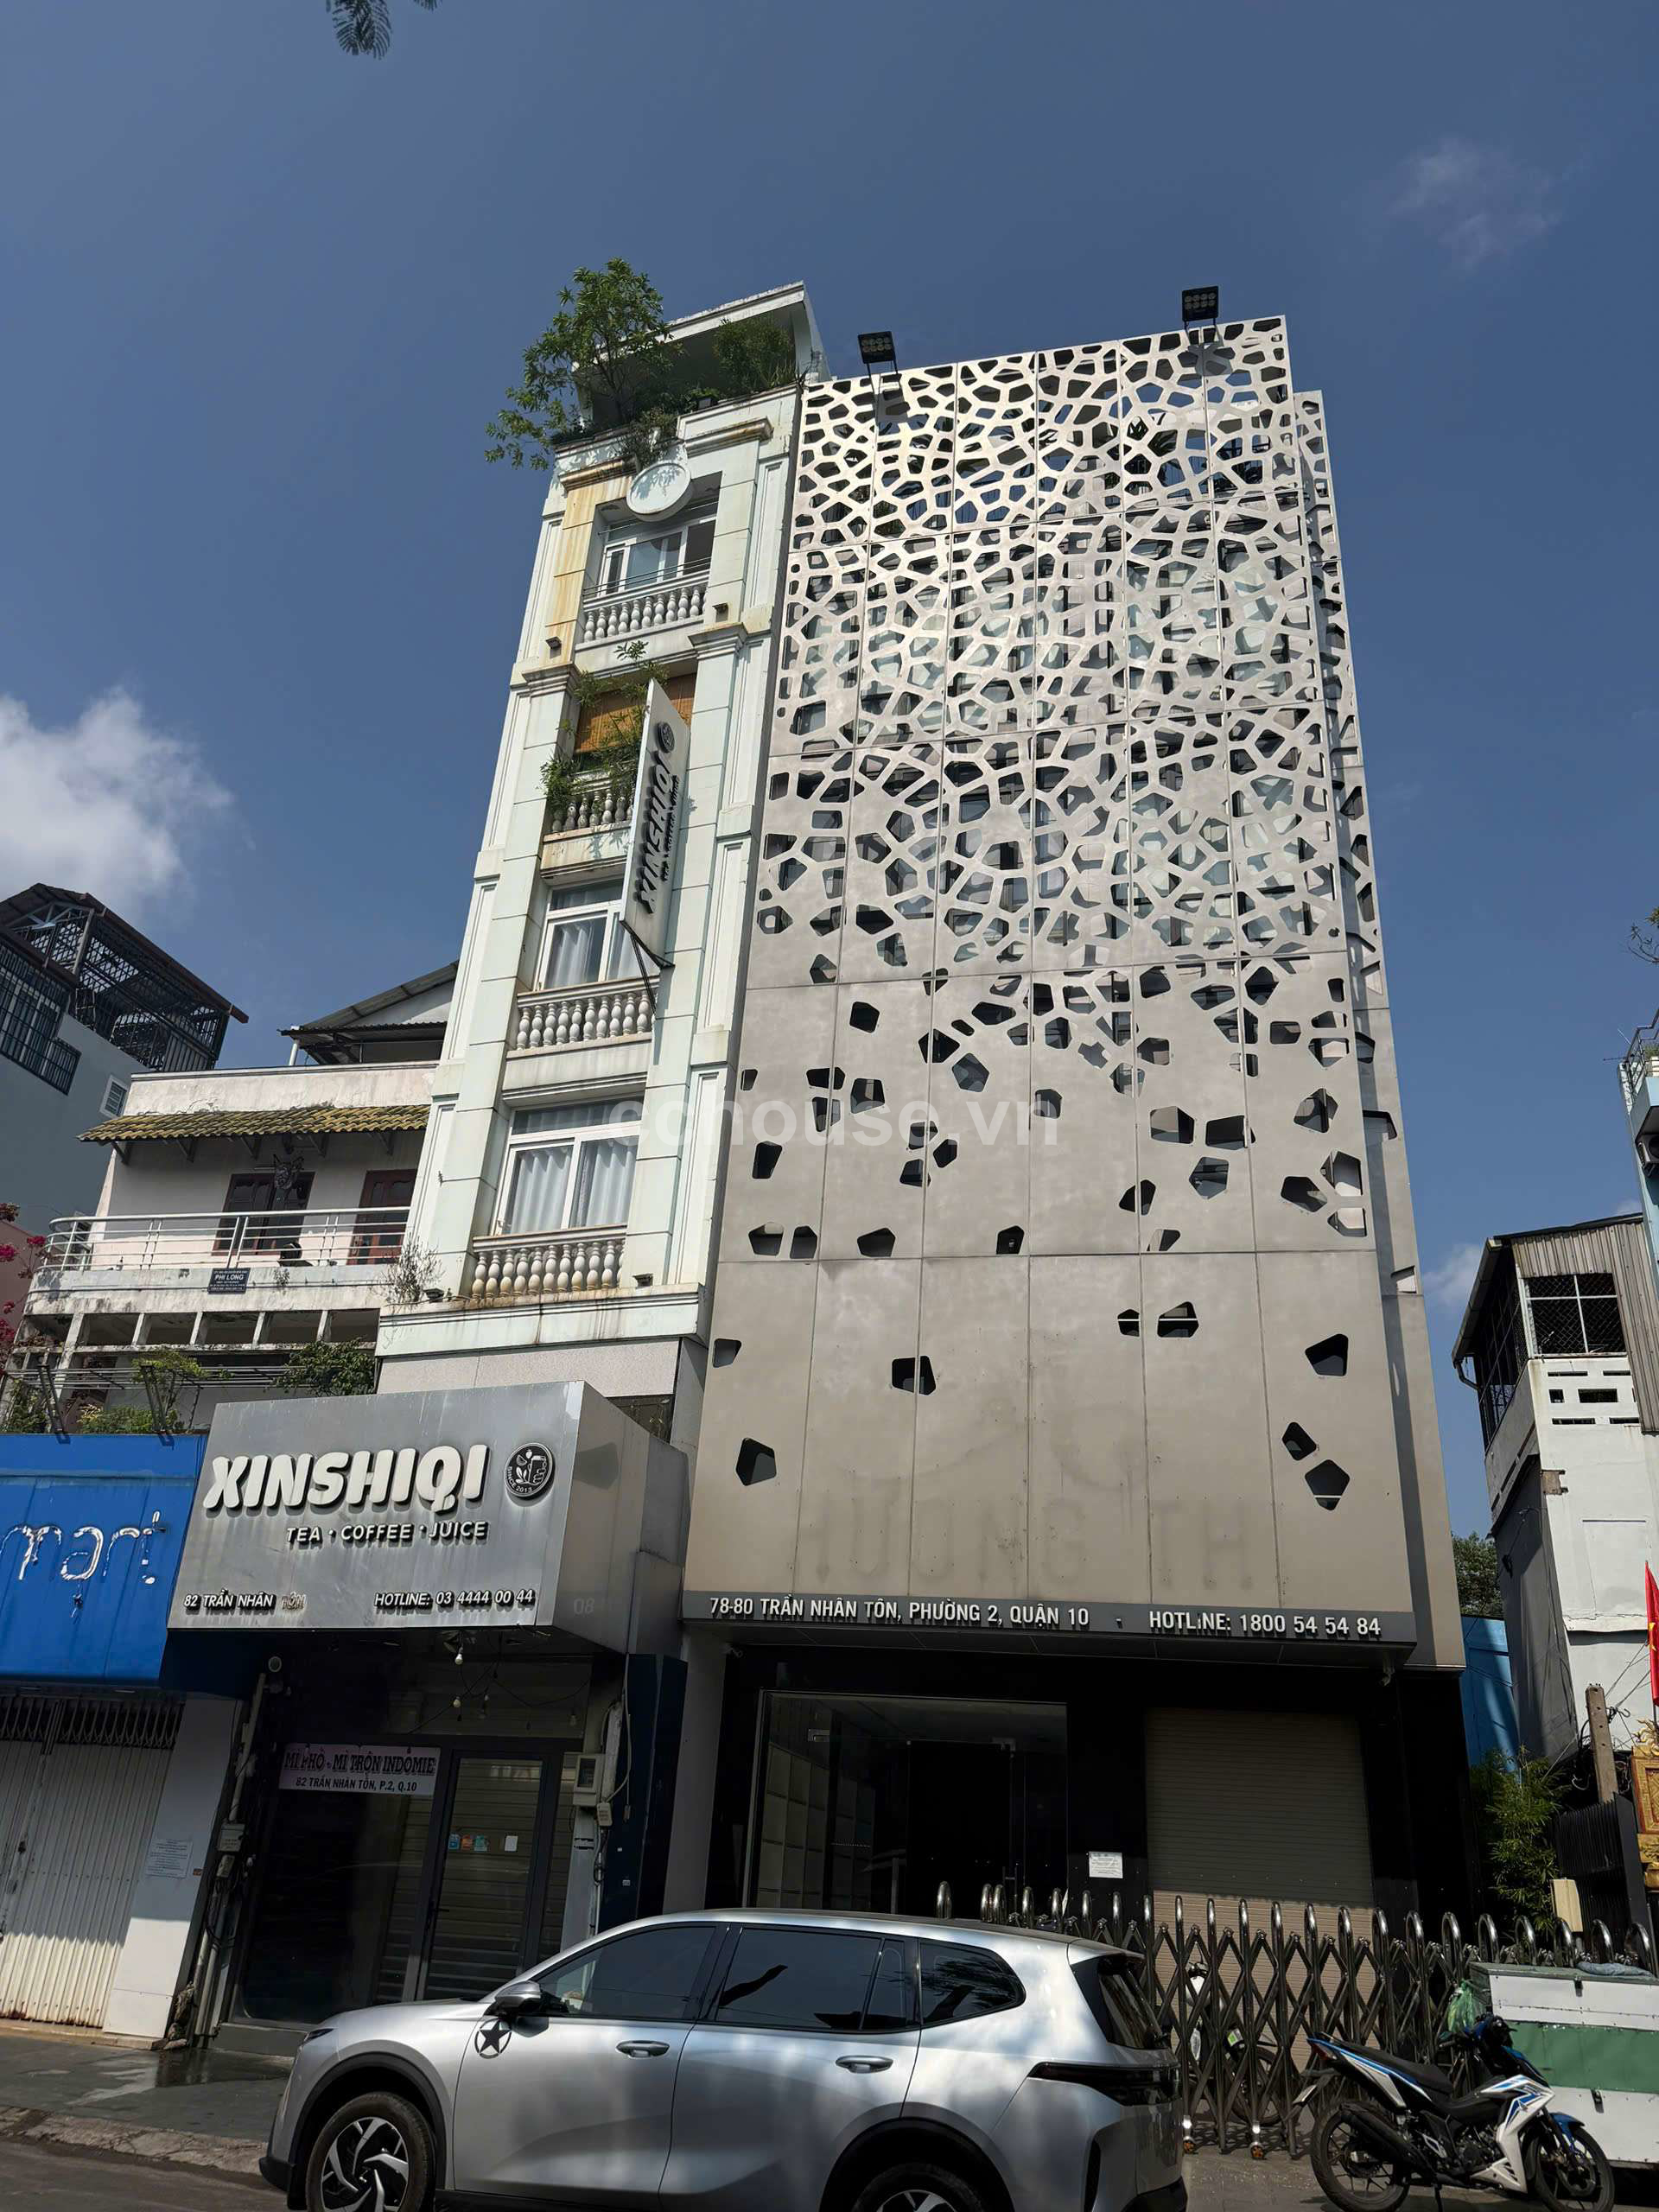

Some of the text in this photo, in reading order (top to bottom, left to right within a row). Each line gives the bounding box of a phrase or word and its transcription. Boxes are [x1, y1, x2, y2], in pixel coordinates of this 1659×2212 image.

[203, 1445, 488, 1513] XINSHIQI
[288, 1522, 486, 1542] TEA COFFEE JUICE
[184, 1594, 198, 1607] 82
[238, 1592, 273, 1607] NHÂN
[374, 1589, 533, 1606] HOTLINE: 03 4444 00 44
[710, 1594, 1089, 1627] 78-80 TRẦN NHÂN TÔN, PHƯỜNG 2, QUẬN 10
[1149, 1611, 1381, 1636] HOTLINE: 1800 54 54 84
[383, 1756, 435, 1774] INDOMIE
[397, 1781, 417, 1792] Q.10
